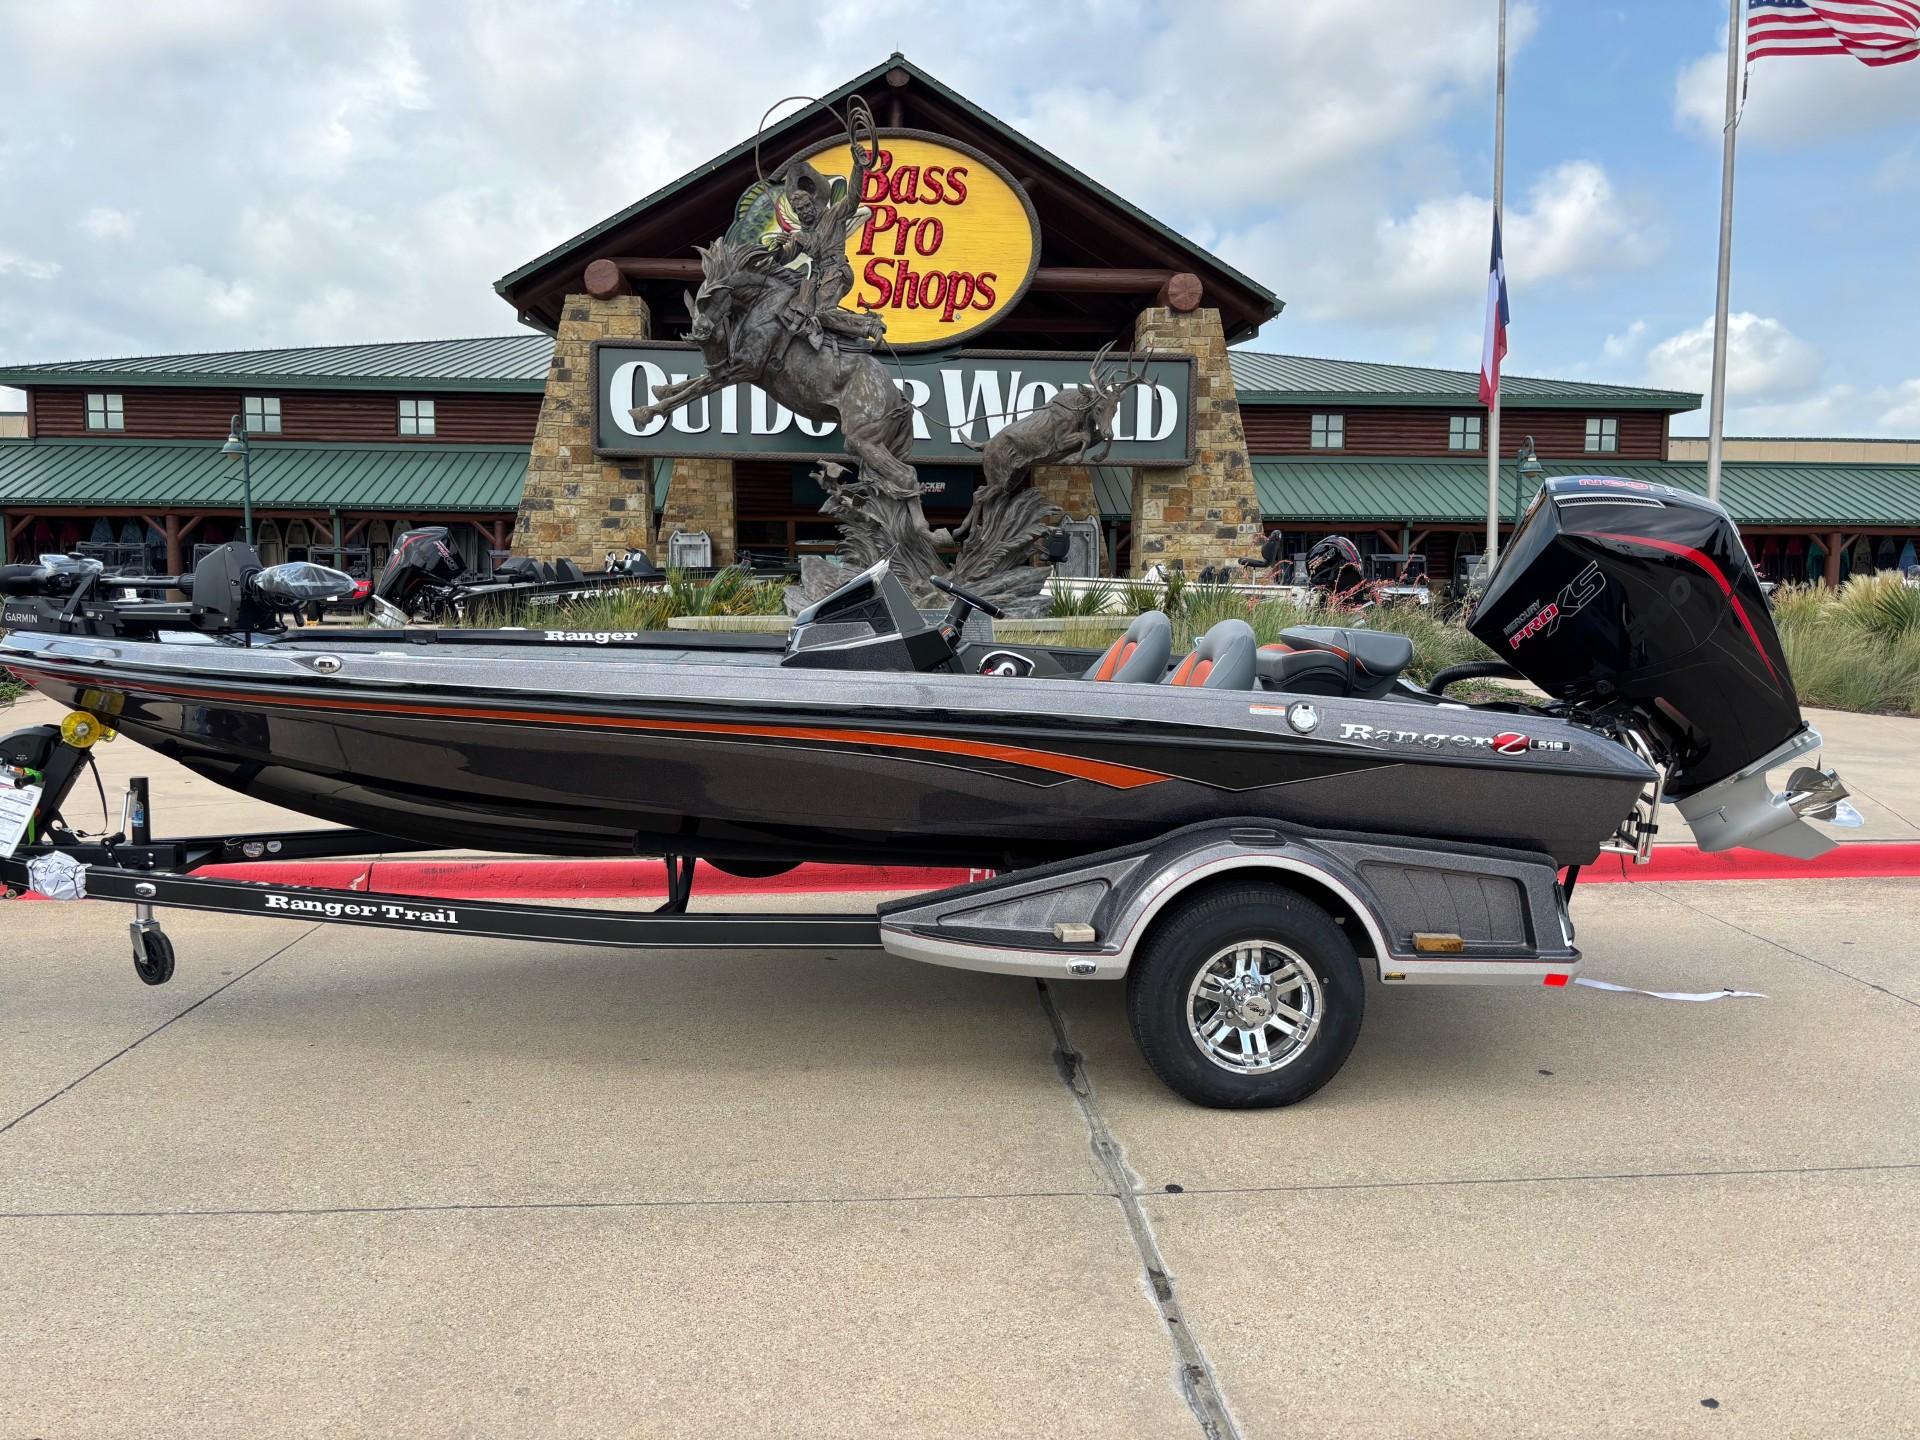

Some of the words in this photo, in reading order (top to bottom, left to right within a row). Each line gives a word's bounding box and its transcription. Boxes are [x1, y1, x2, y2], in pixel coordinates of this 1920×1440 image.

[860, 150, 968, 206] Bass
[856, 205, 944, 256] Pro
[857, 257, 997, 322] Shops
[609, 360, 932, 440] OUTDR
[940, 369, 1178, 443] WOLD
[5, 612, 38, 624] GARMIN
[544, 630, 638, 644] Ranger
[1503, 599, 1541, 636] MERCURY
[1509, 602, 1559, 650] PRO
[1340, 723, 1493, 750] Ranger
[265, 894, 377, 916] Ranger
[381, 905, 458, 924] Trail
